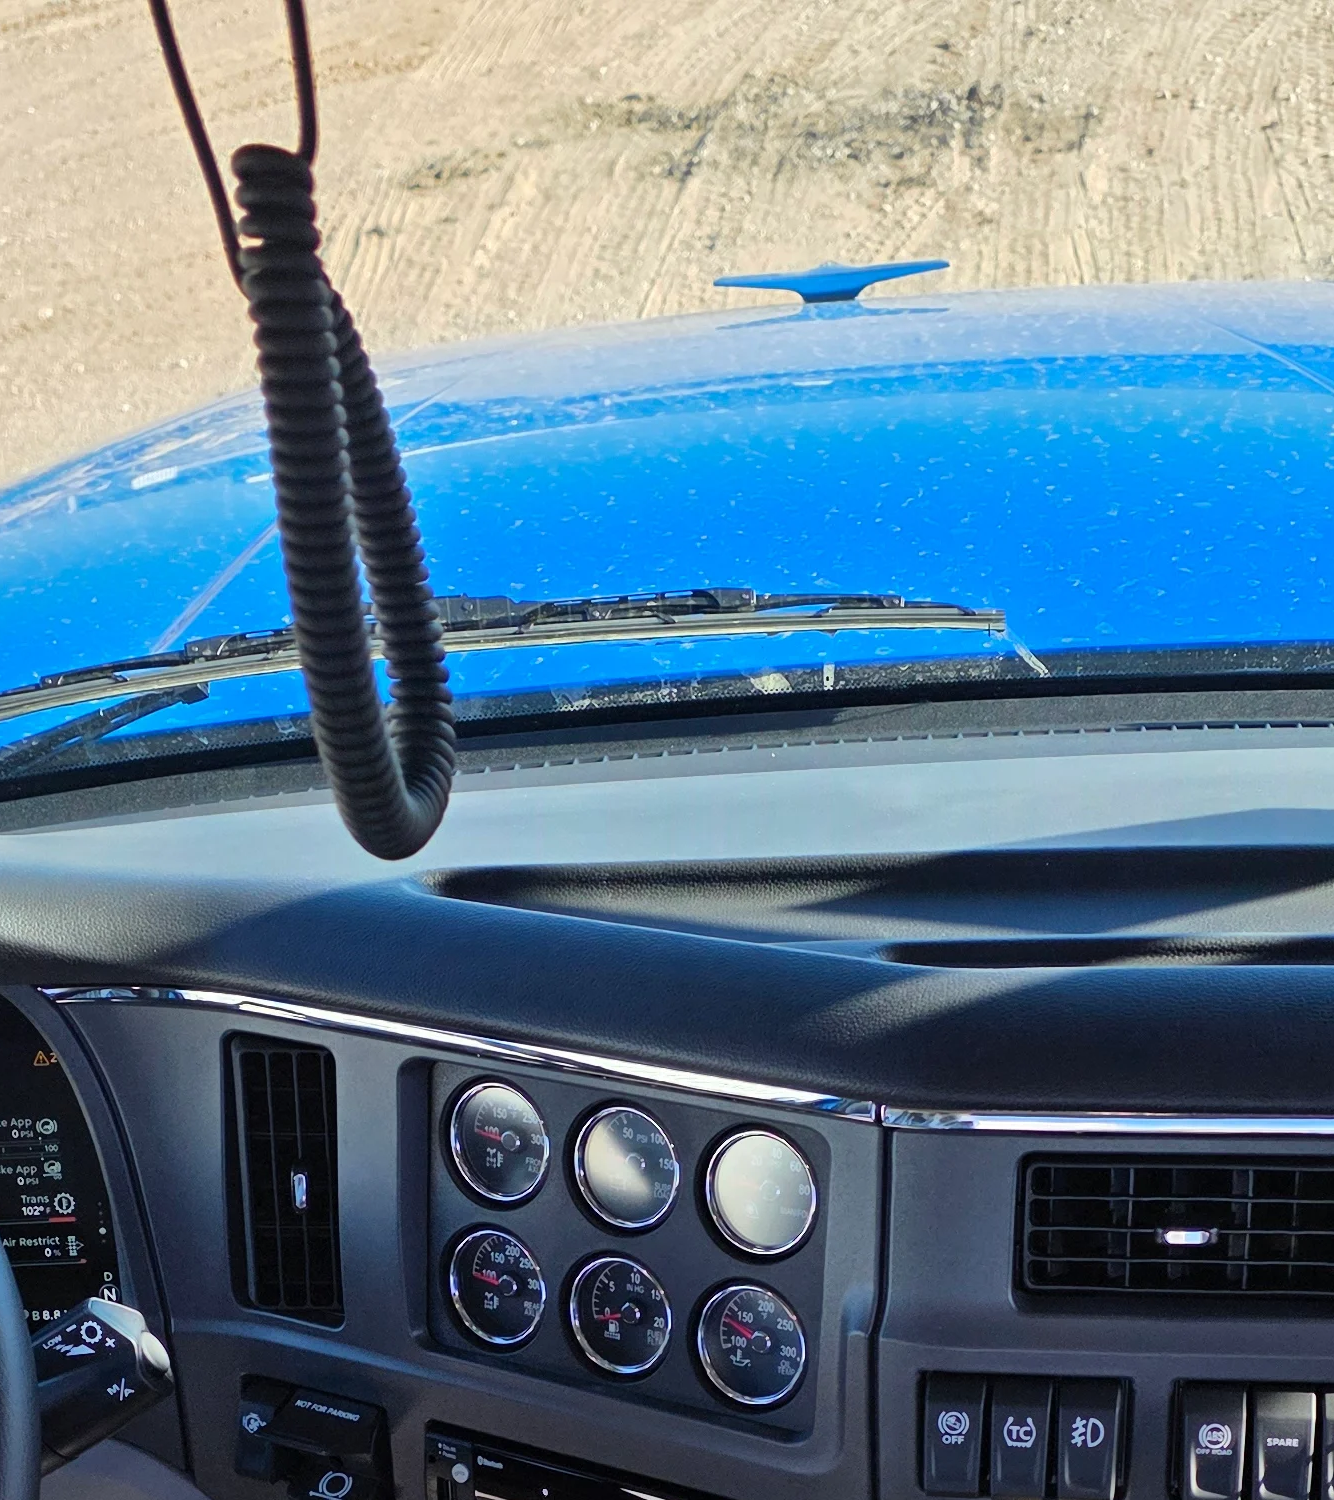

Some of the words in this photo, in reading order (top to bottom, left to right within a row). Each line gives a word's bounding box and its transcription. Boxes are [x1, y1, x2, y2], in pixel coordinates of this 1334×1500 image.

[492, 1106, 507, 1119] 150
[10, 1117, 32, 1129] App
[12, 1129, 19, 1139] 0
[20, 1130, 33, 1138] PSI
[623, 1127, 634, 1140] 50
[636, 1133, 648, 1144] PSI
[44, 1144, 59, 1152] 100
[16, 1165, 38, 1176] App
[789, 1161, 802, 1173] 60
[17, 1176, 25, 1186] 0
[26, 1177, 39, 1185] PSI
[798, 1184, 811, 1196] 80
[21, 1194, 50, 1205] Trans
[2, 1238, 16, 1247] Air
[19, 1236, 60, 1247] Restrict
[44, 1248, 52, 1258] 0
[505, 1244, 521, 1258] 200
[490, 1251, 505, 1264] 150
[104, 1271, 113, 1282] D
[630, 1272, 641, 1285] 10
[609, 1280, 616, 1293] 5
[103, 1287, 117, 1301] N
[651, 1289, 661, 1301] 15
[758, 1300, 775, 1313] 200
[653, 1316, 665, 1329] 20
[737, 1310, 753, 1323] 150
[776, 1318, 794, 1331] 250
[730, 1335, 747, 1348] 100
[779, 1345, 797, 1358] 300
[295, 1399, 312, 1409] NOT
[311, 1403, 328, 1413] FOR
[1008, 1425, 1031, 1441] TC
[1205, 1430, 1224, 1442] ABS
[941, 1435, 965, 1445] OFF
[1267, 1437, 1299, 1448] SPARE
